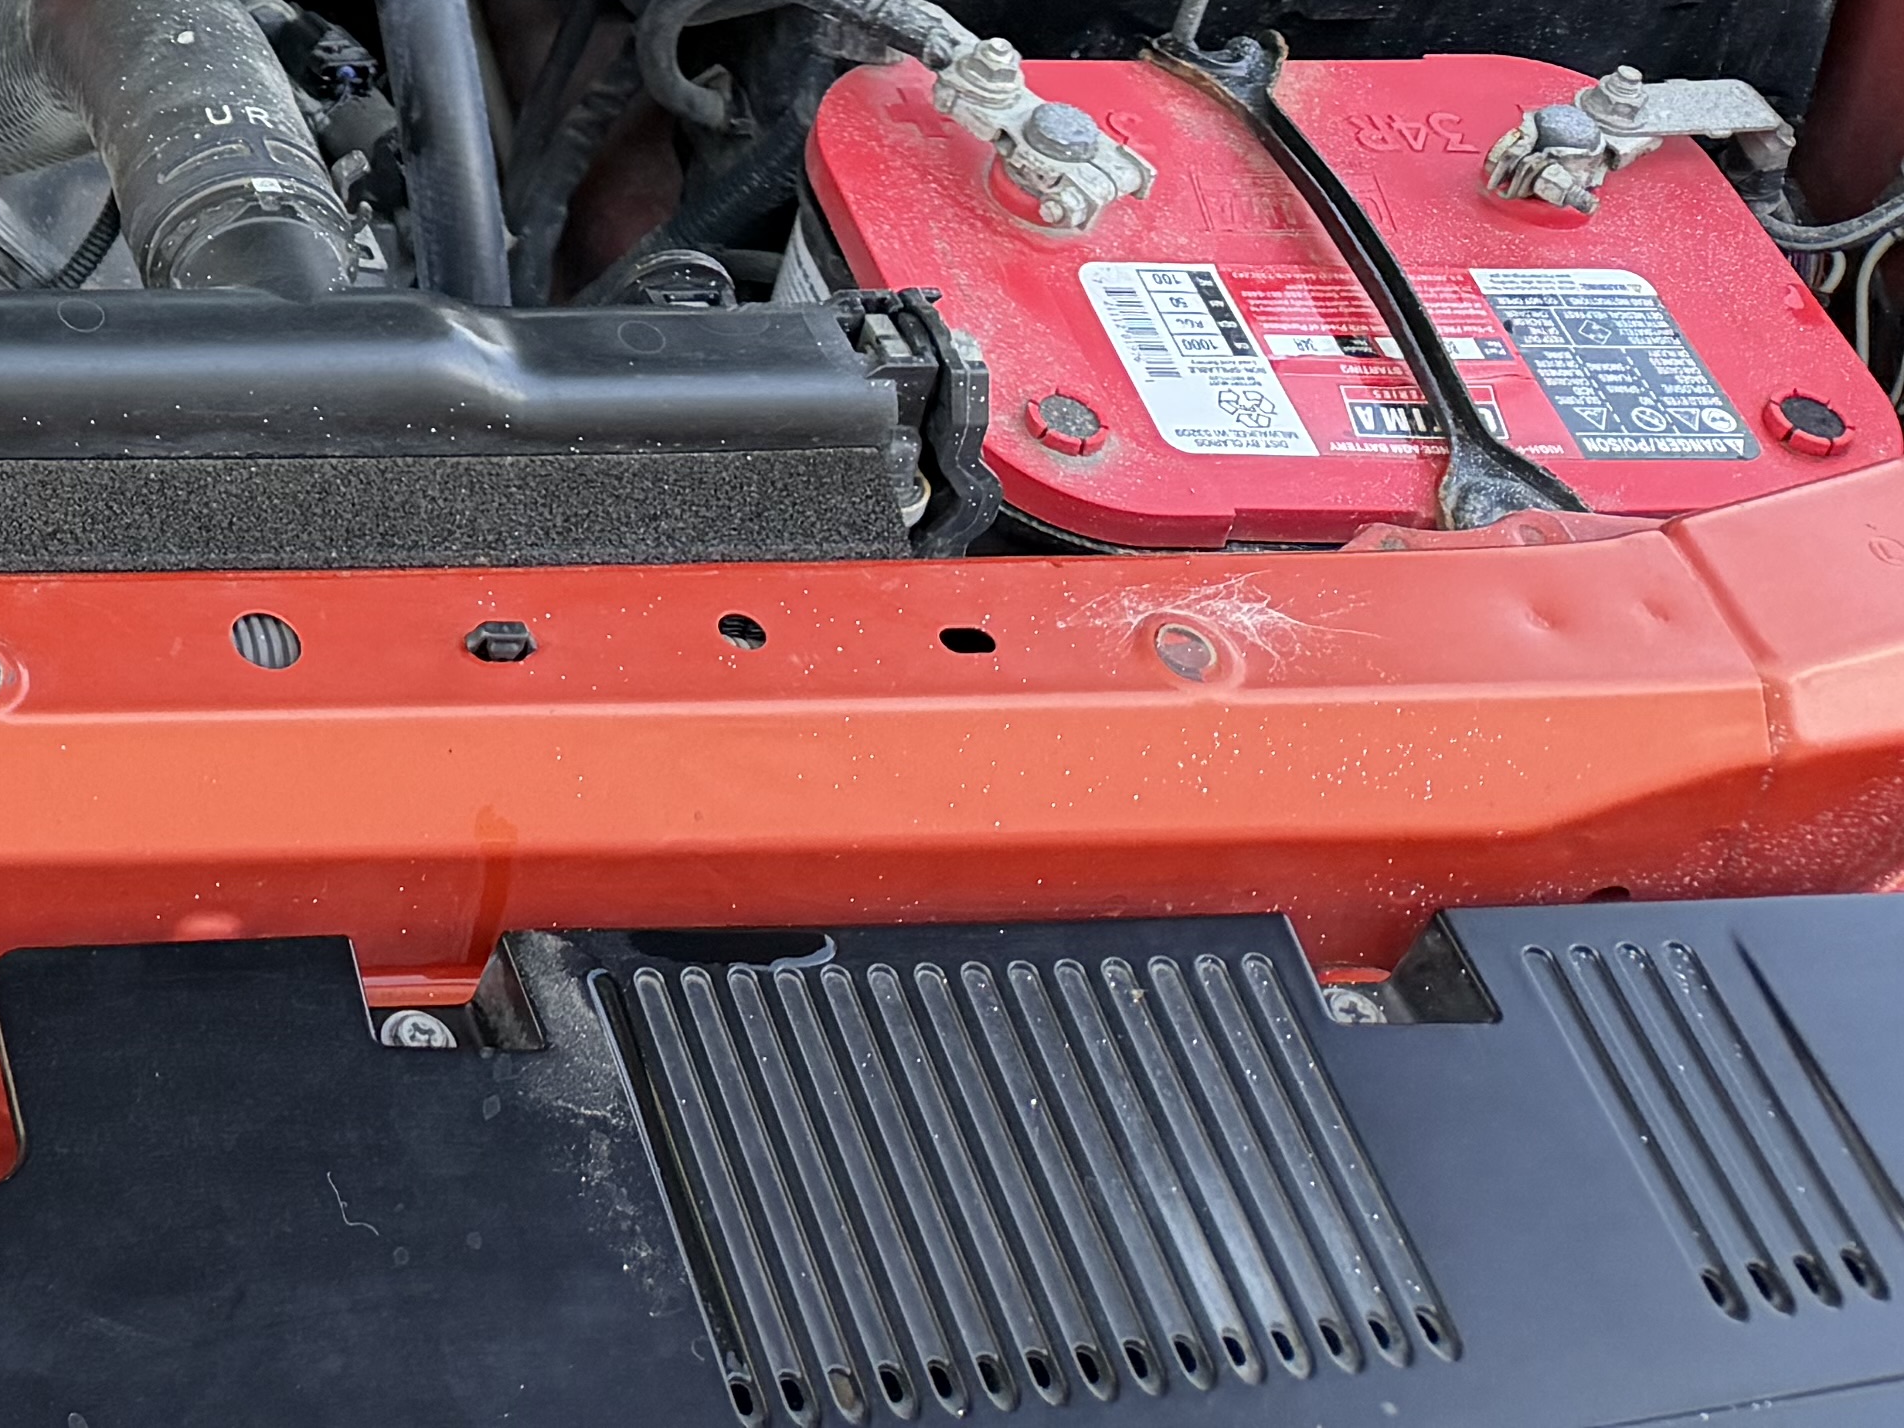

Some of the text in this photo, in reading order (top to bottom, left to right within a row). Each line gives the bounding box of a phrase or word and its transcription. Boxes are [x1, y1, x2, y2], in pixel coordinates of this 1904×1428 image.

[1152, 273, 1183, 286] 100
[1169, 296, 1189, 309] 50
[1182, 338, 1218, 351] 1000
[1339, 363, 1404, 376] STARTING
[1372, 389, 1425, 401] ERIES
[1329, 442, 1387, 453] BATTERY
[1583, 436, 1727, 453] DANGER/POISON
